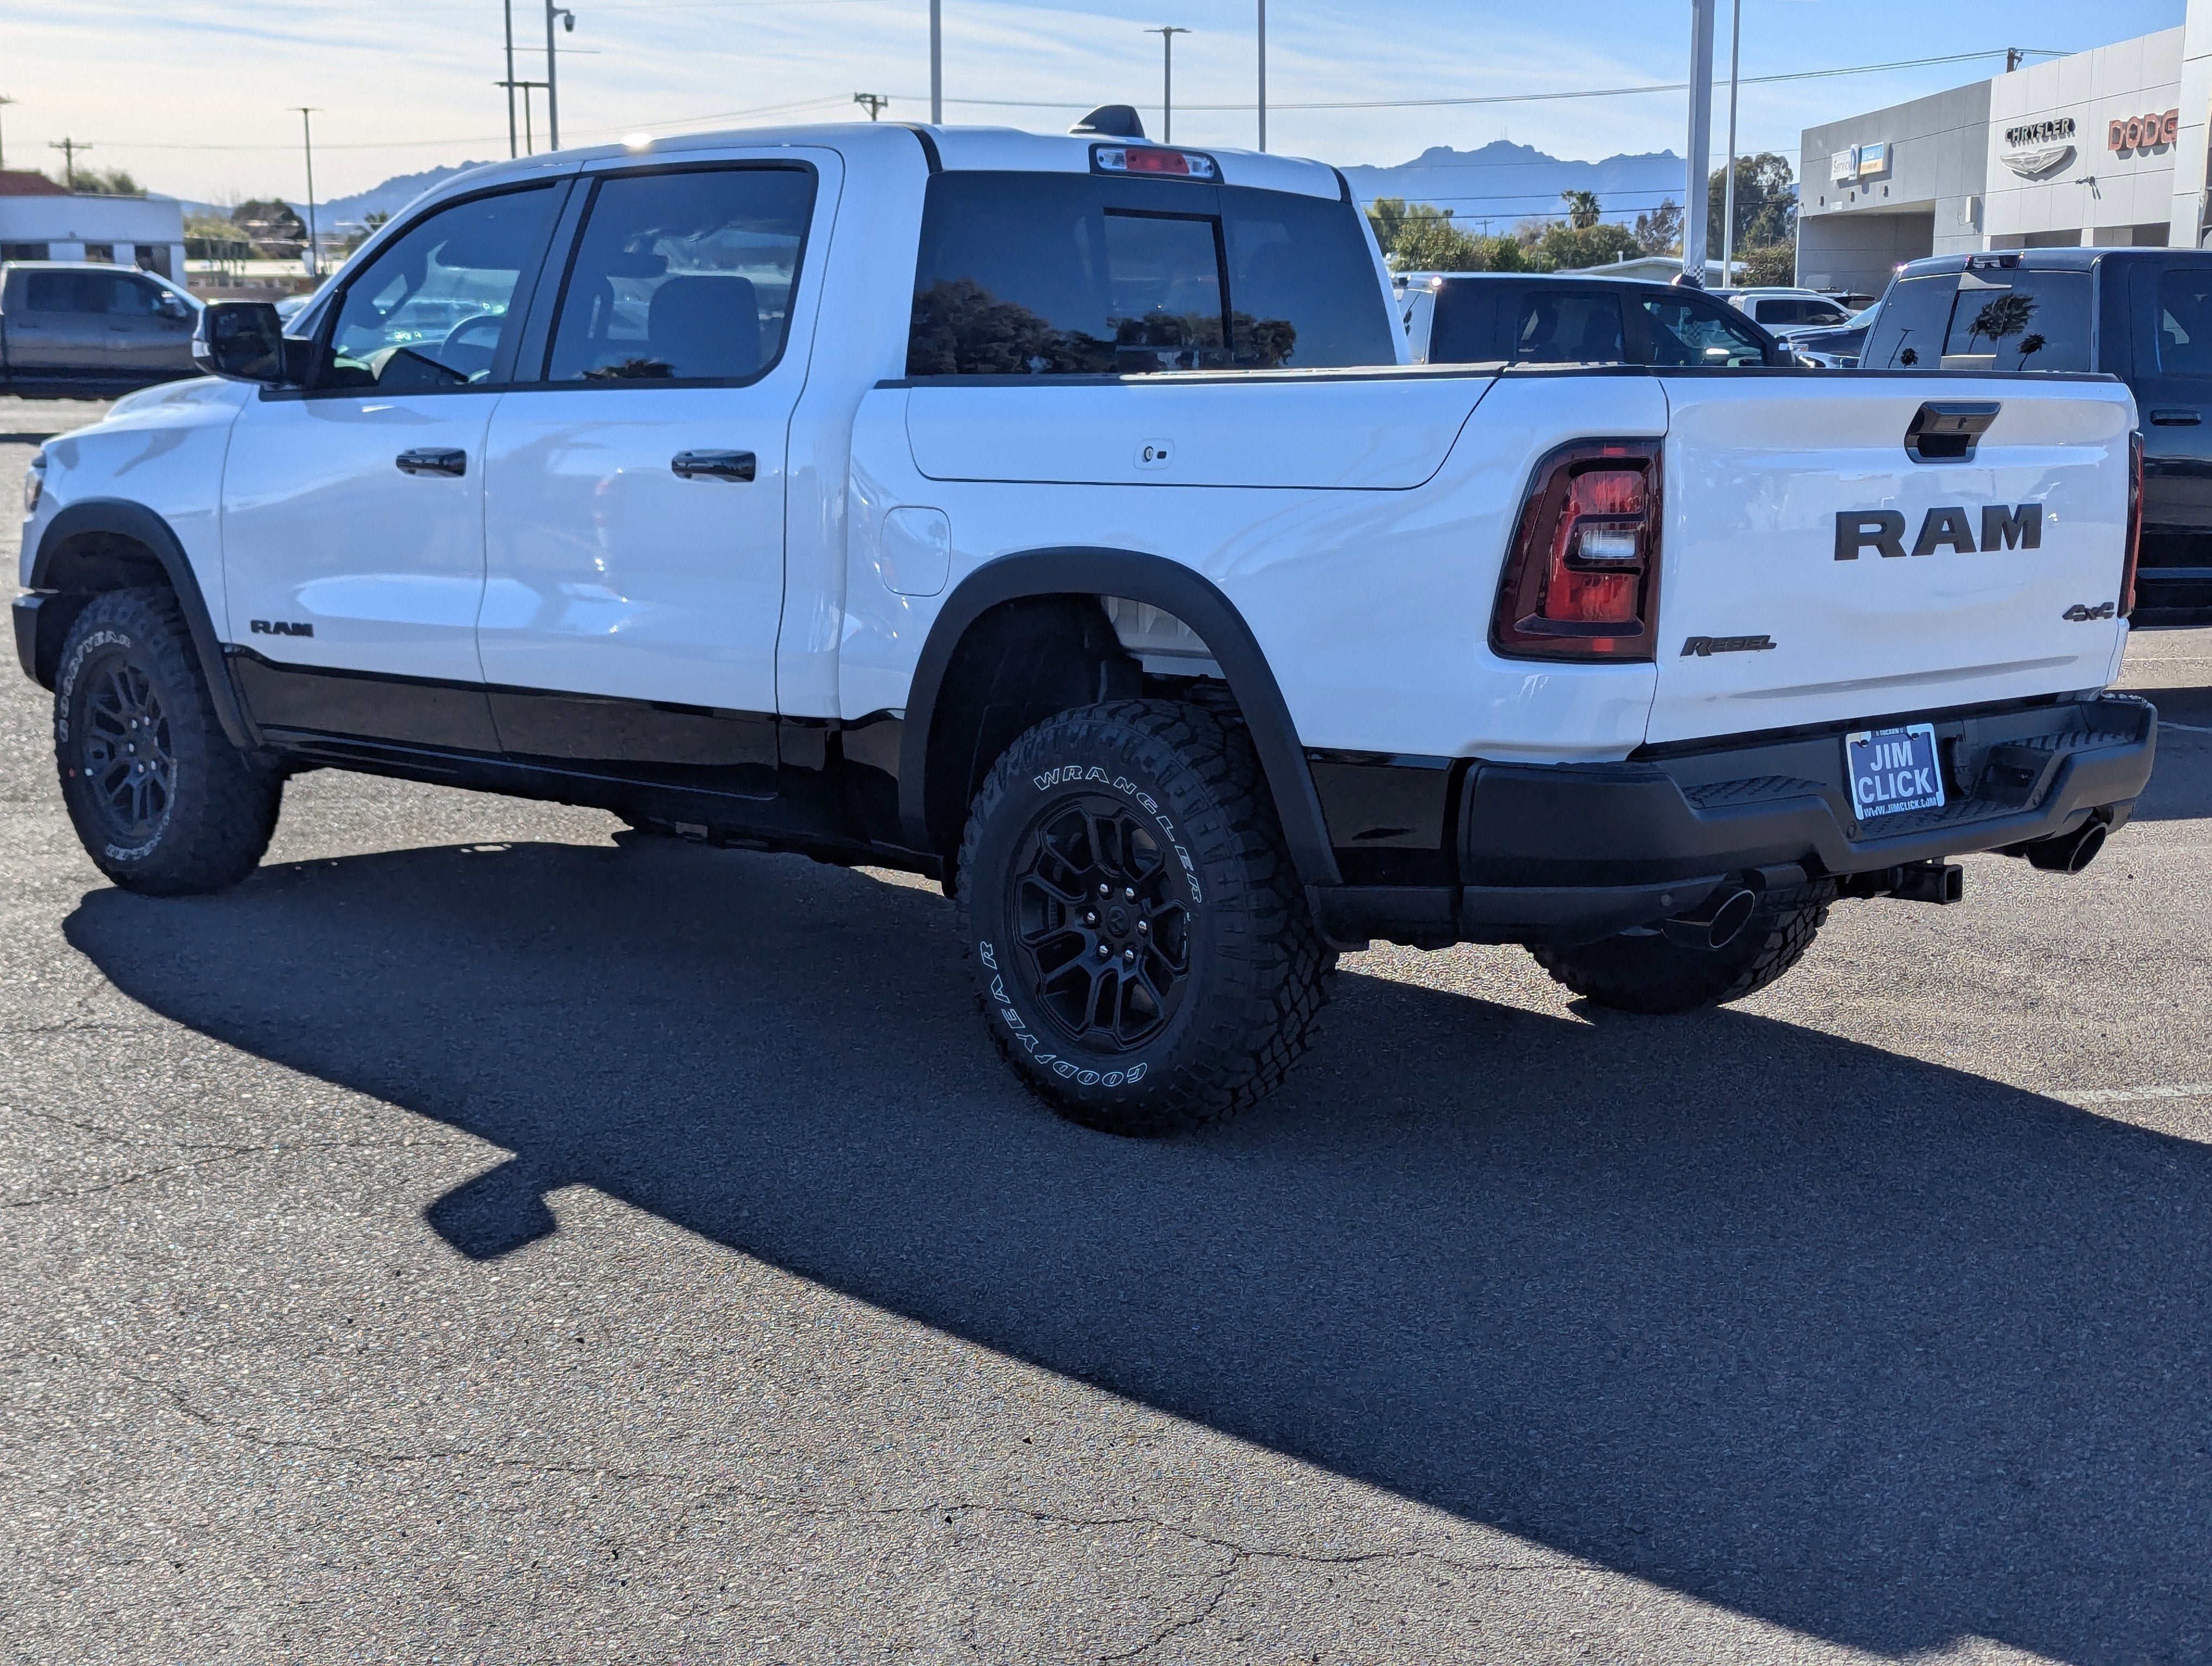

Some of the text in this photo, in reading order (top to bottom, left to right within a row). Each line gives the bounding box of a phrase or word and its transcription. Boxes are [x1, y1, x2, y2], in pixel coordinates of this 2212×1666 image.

[2005, 118, 2072, 143] CHRYSLER
[2107, 108, 2179, 151] DODG
[1834, 503, 2042, 561] RAM
[251, 620, 314, 638] RAM
[1870, 741, 1913, 771] JIM
[1858, 767, 1933, 803] CLICK
[1033, 765, 1203, 904] WRANGLER
[980, 940, 1147, 1087] GOODYEAR
